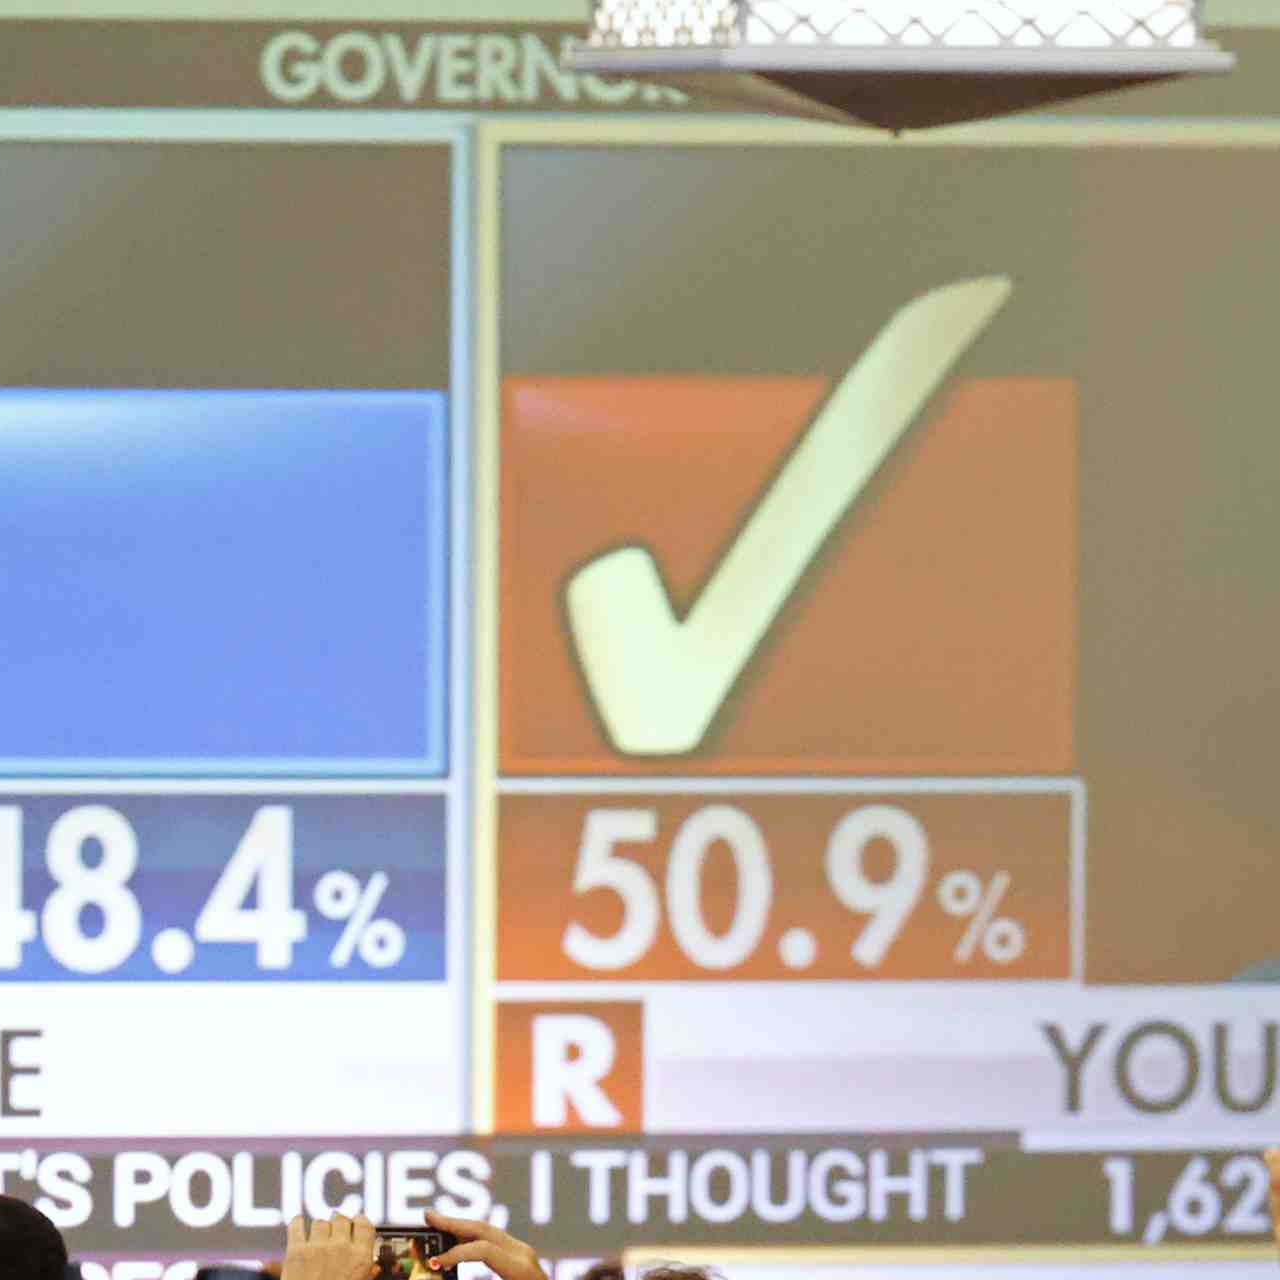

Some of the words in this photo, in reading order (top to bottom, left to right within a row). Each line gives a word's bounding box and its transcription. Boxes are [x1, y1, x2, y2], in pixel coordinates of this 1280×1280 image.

[260, 30, 689, 102] GOVERN
[561, 804, 1029, 972] 50.9%
[531, 1014, 622, 1129] R
[113, 1150, 509, 1230] POLICIES,
[530, 1152, 552, 1225] I
[570, 1149, 984, 1224] THOUGHT
